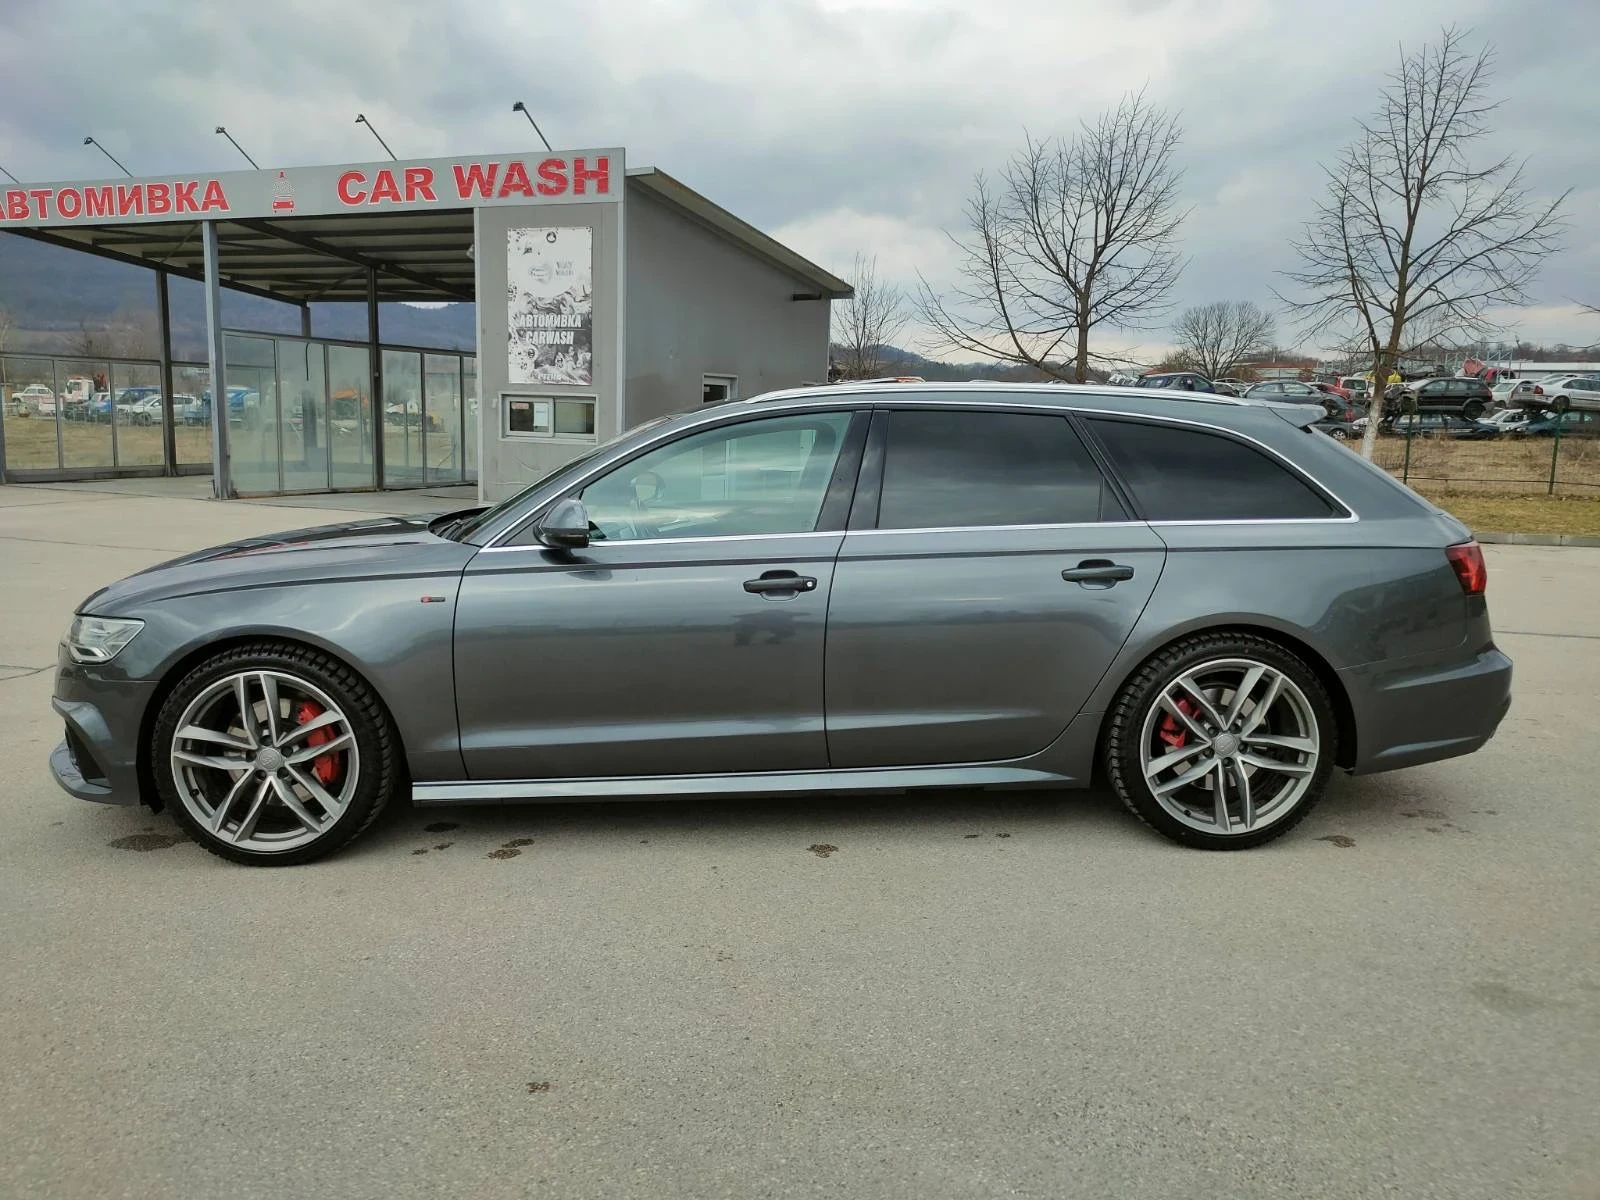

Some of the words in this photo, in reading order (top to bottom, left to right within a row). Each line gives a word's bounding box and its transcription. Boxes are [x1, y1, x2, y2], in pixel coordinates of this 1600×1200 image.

[337, 167, 438, 206] CAR
[452, 156, 610, 200] WASH
[0, 179, 230, 220] ВТОМИВКА
[519, 314, 582, 328] АВТОМИВКА
[525, 331, 575, 345] CARWASH
